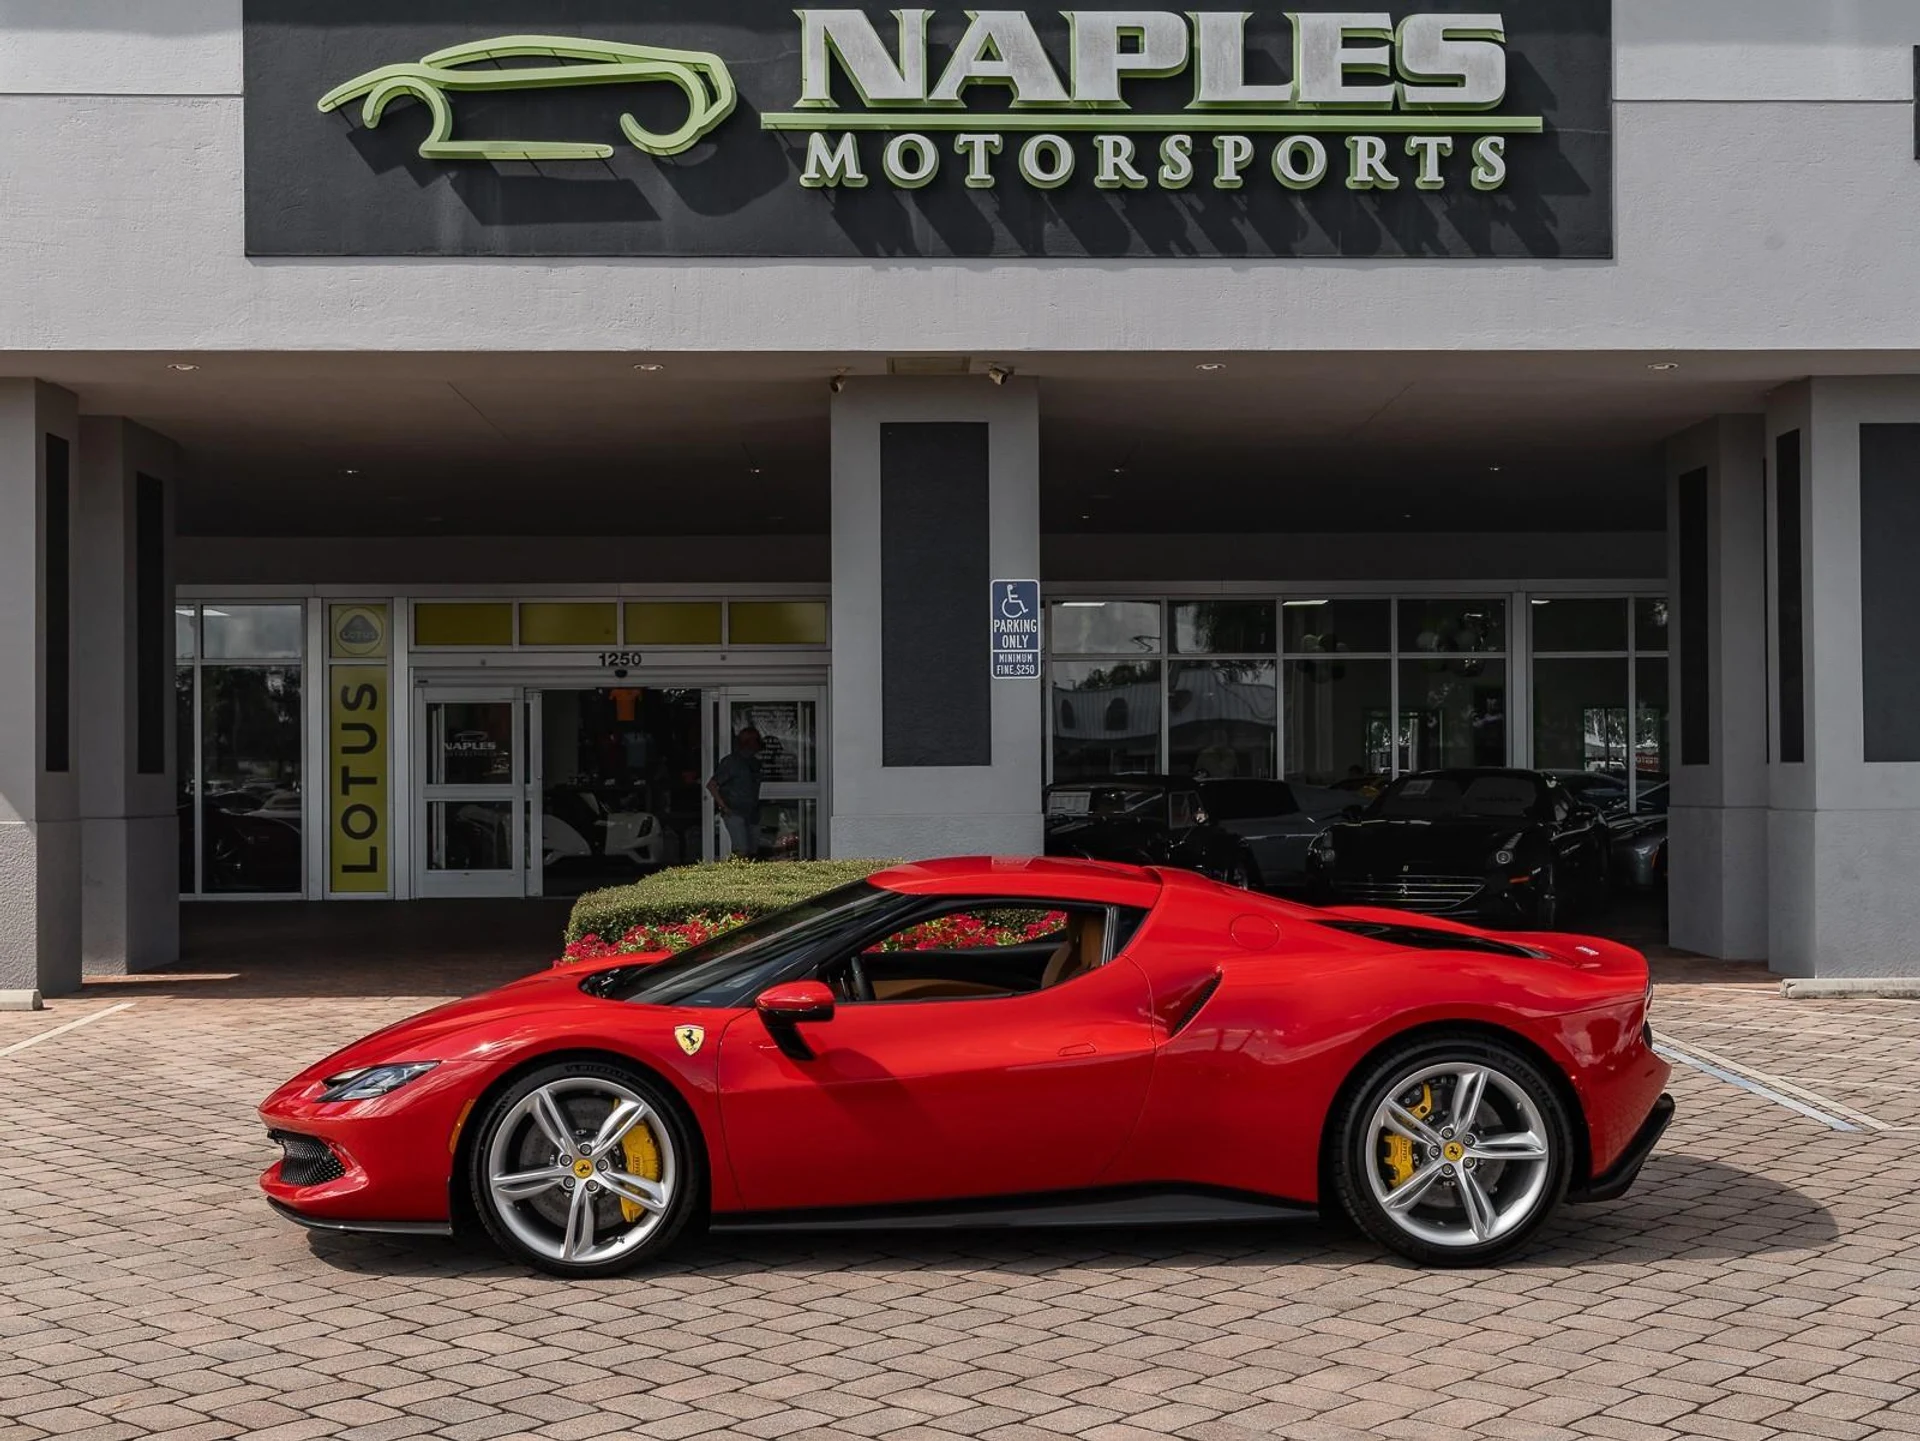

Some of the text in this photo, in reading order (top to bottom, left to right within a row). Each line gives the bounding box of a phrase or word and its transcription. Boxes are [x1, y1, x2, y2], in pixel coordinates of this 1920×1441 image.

[795, 9, 1507, 109] NAPLES
[800, 133, 1507, 190] MOTORSPORTS
[994, 619, 1037, 633] PARKING
[1002, 635, 1029, 648] ONLY
[598, 652, 642, 667] 1250
[999, 653, 1033, 663] MINIMUM
[997, 664, 1035, 675] FINE $250
[444, 741, 497, 750] NAPLES
[341, 683, 378, 873] LOTUS
